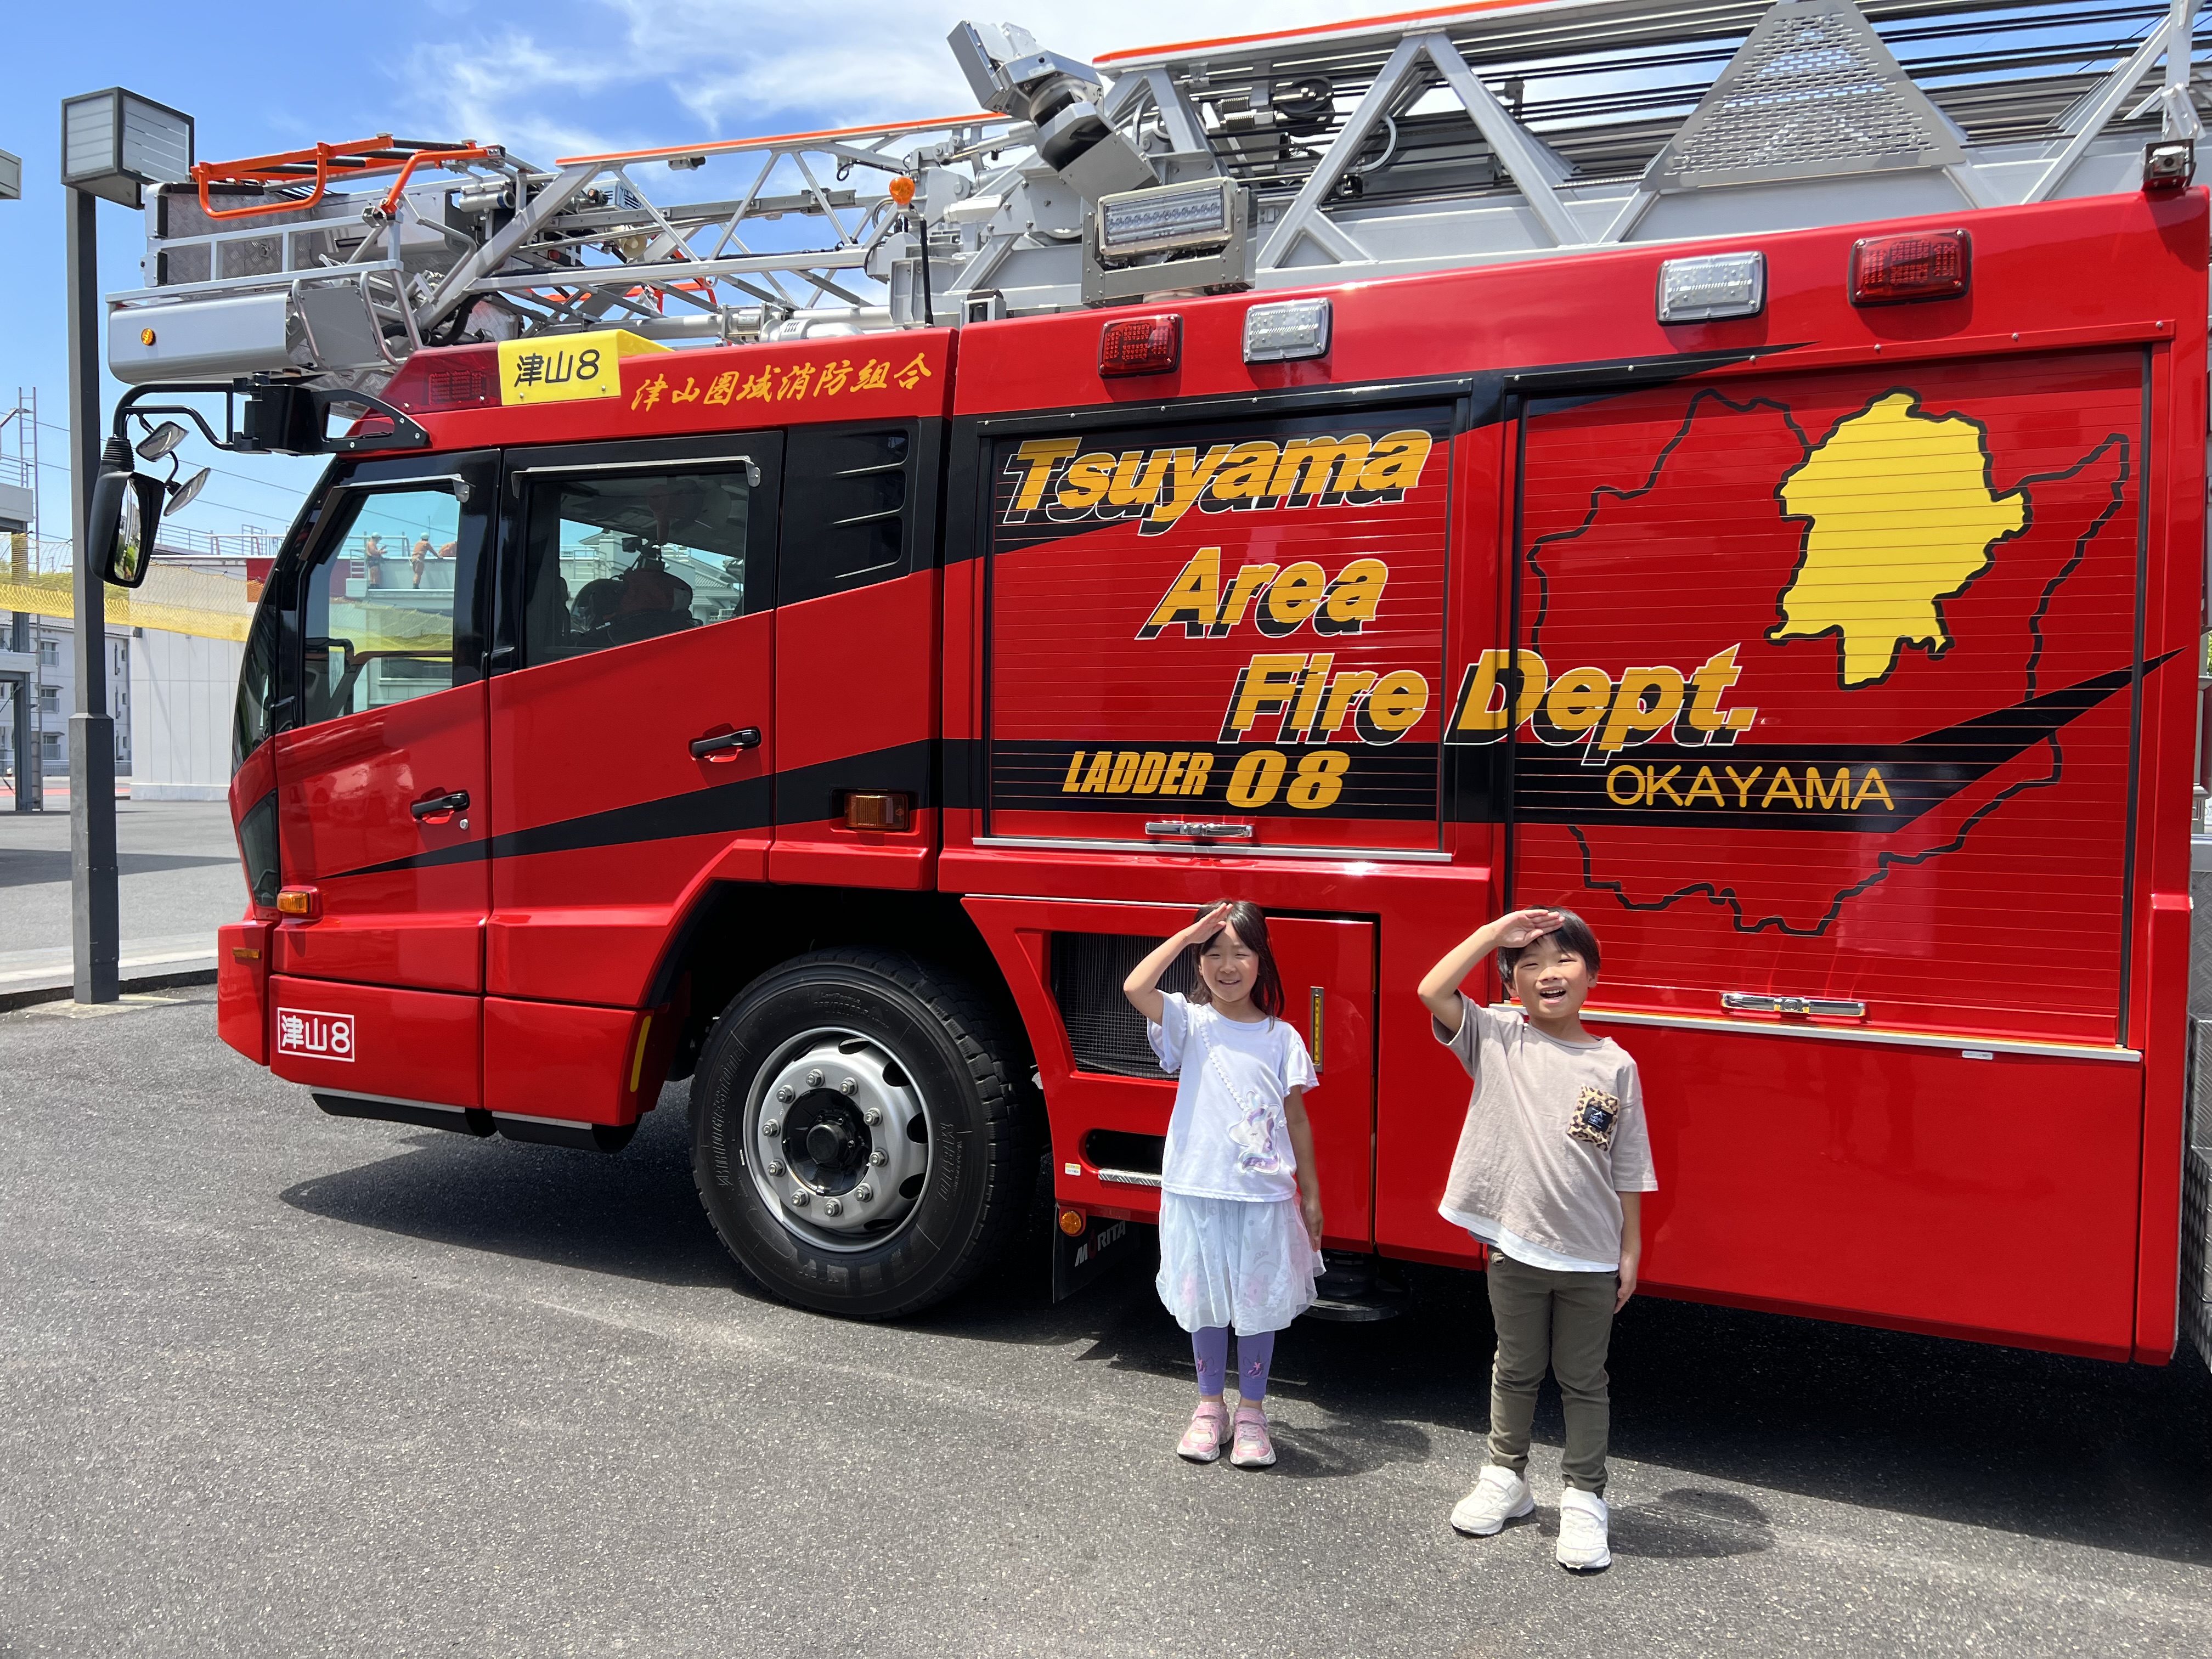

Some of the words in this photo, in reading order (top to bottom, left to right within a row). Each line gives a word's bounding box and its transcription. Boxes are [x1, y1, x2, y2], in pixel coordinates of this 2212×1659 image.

[514, 349, 600, 387] 津山8
[1002, 429, 1433, 537] Tsuyama
[1135, 546, 1389, 640] Area
[1217, 653, 1429, 745] Fire
[1443, 642, 1759, 766] Dept.
[1062, 750, 1215, 796] LADDER
[1225, 749, 1351, 809] 08
[1606, 764, 1894, 811] OKAYAMA
[281, 1014, 350, 1053] 津山8
[712, 1042, 745, 1186] BRIDGESTONE
[1074, 1220, 1126, 1267] MORITA
